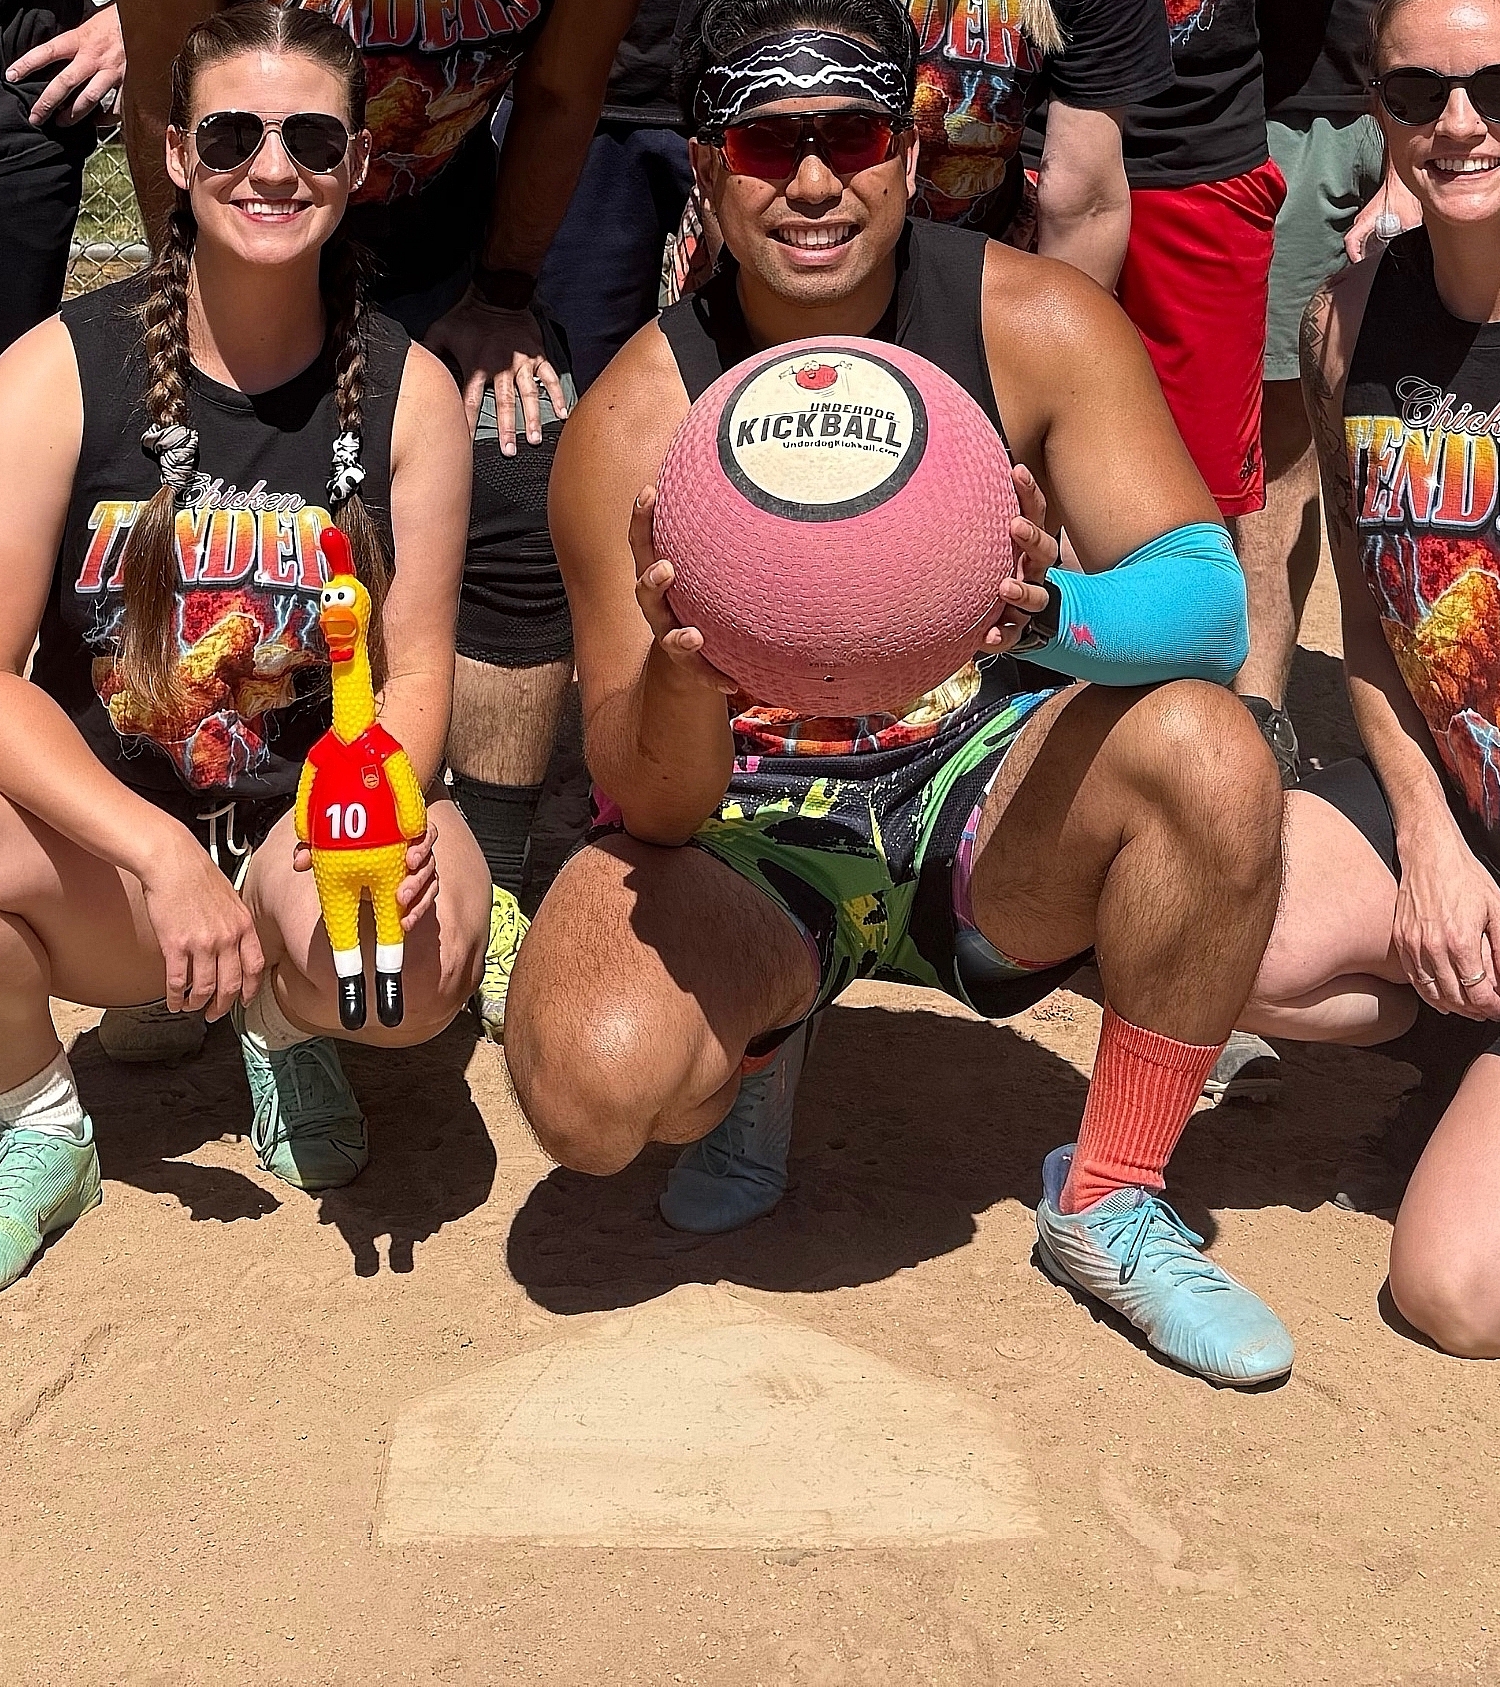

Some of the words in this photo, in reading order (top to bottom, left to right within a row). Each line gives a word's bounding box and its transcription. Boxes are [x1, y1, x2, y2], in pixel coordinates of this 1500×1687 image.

[811, 403, 896, 421] UNDERDOG
[737, 413, 901, 448] KICKBALL
[326, 802, 367, 839] 10
